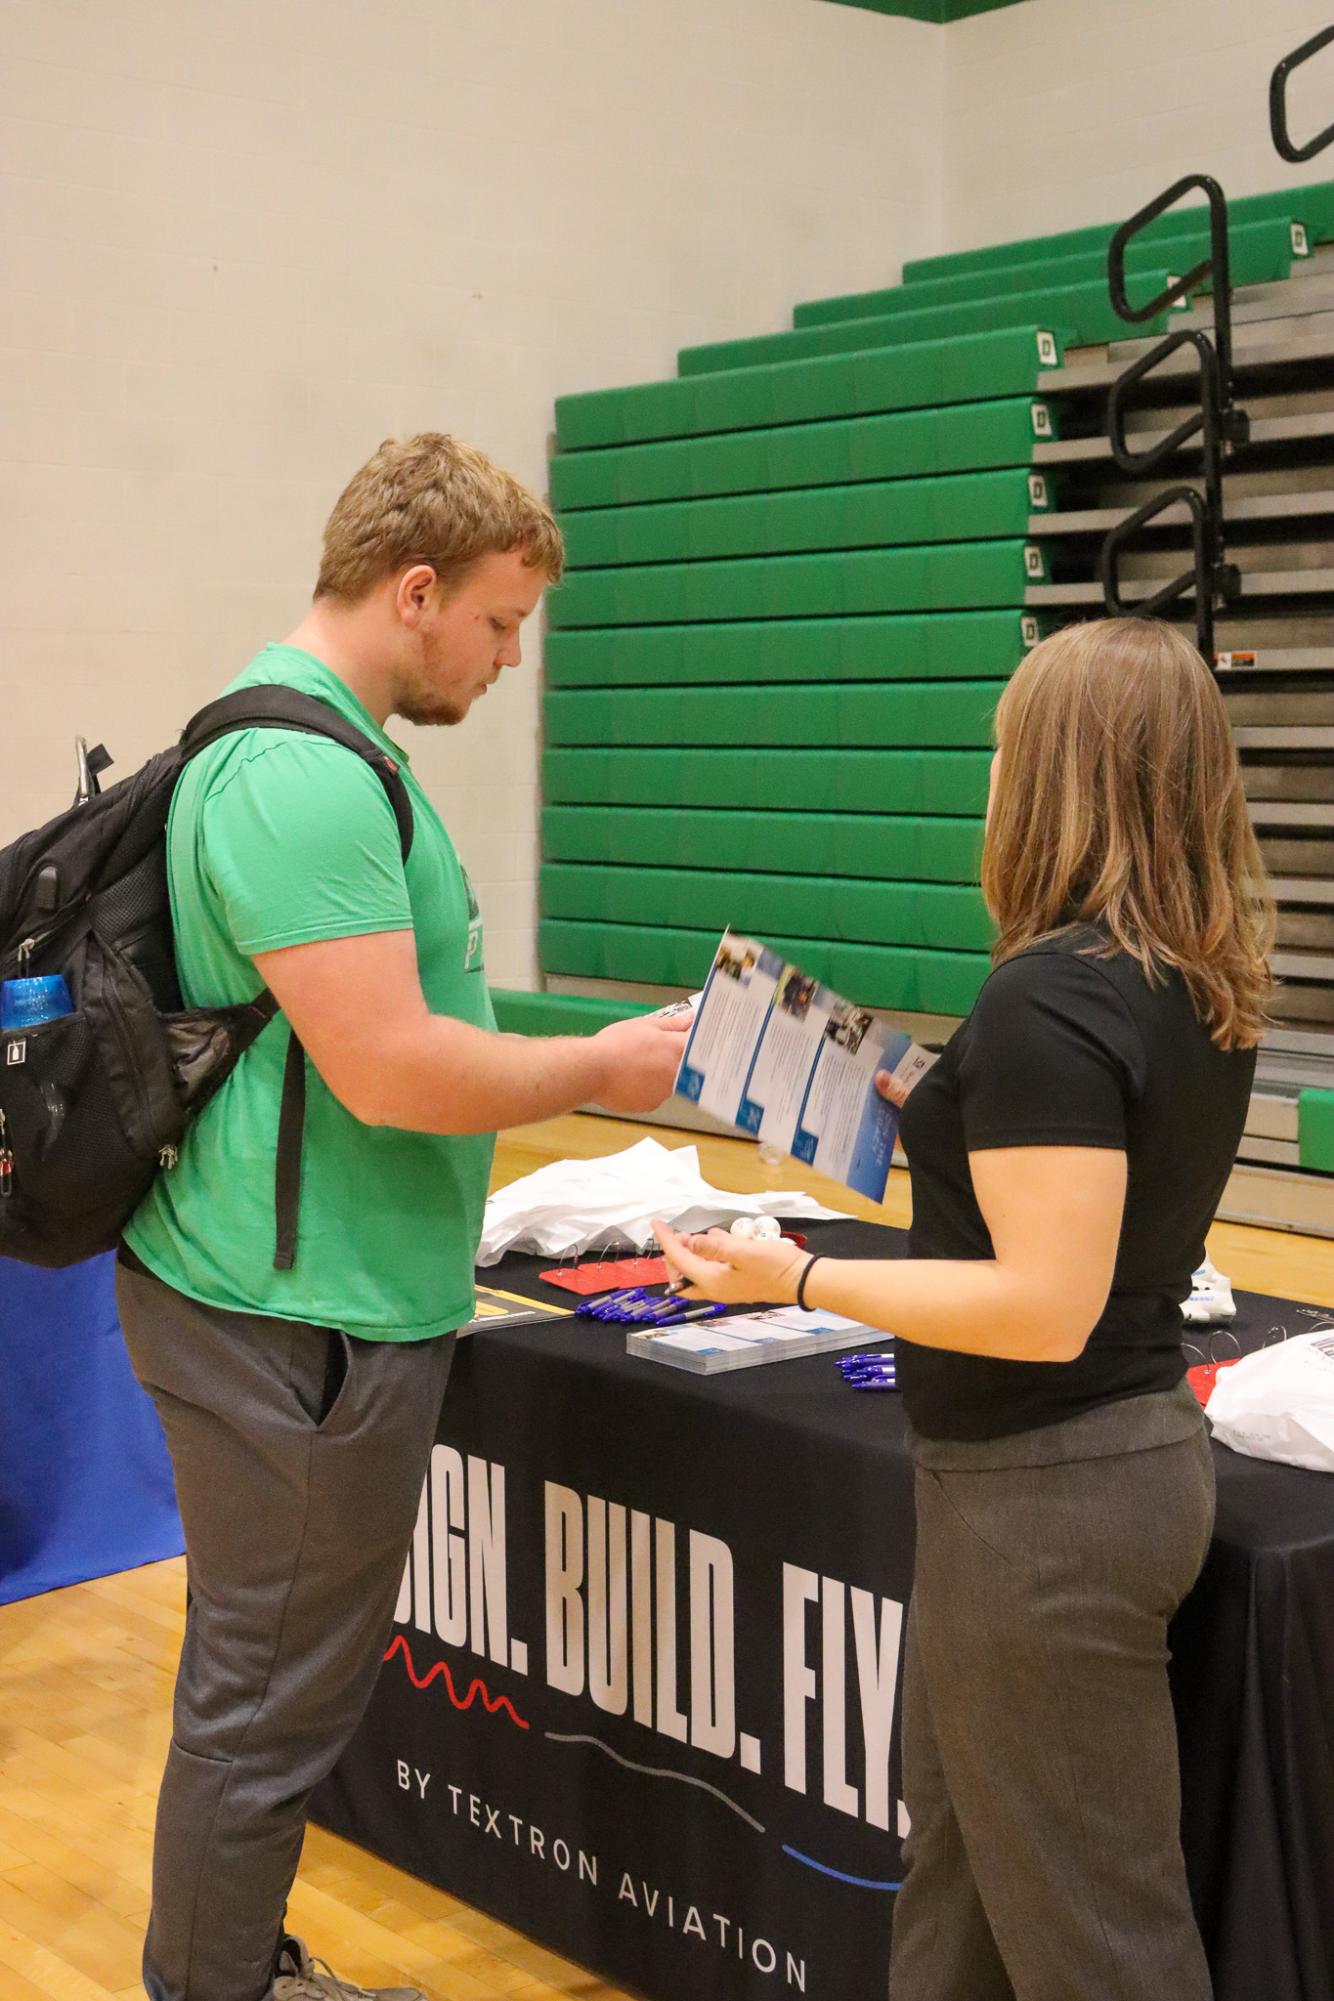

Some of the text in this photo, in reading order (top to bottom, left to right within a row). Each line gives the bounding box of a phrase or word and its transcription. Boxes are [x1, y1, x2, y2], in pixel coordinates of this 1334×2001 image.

[1033, 482, 1042, 499] D
[1029, 553, 1039, 570] D
[1026, 624, 1035, 640] D
[393, 1443, 912, 1840] IGN. BUILD. FLY.
[397, 1759, 806, 1994] BY TEXTRON AVIATION
